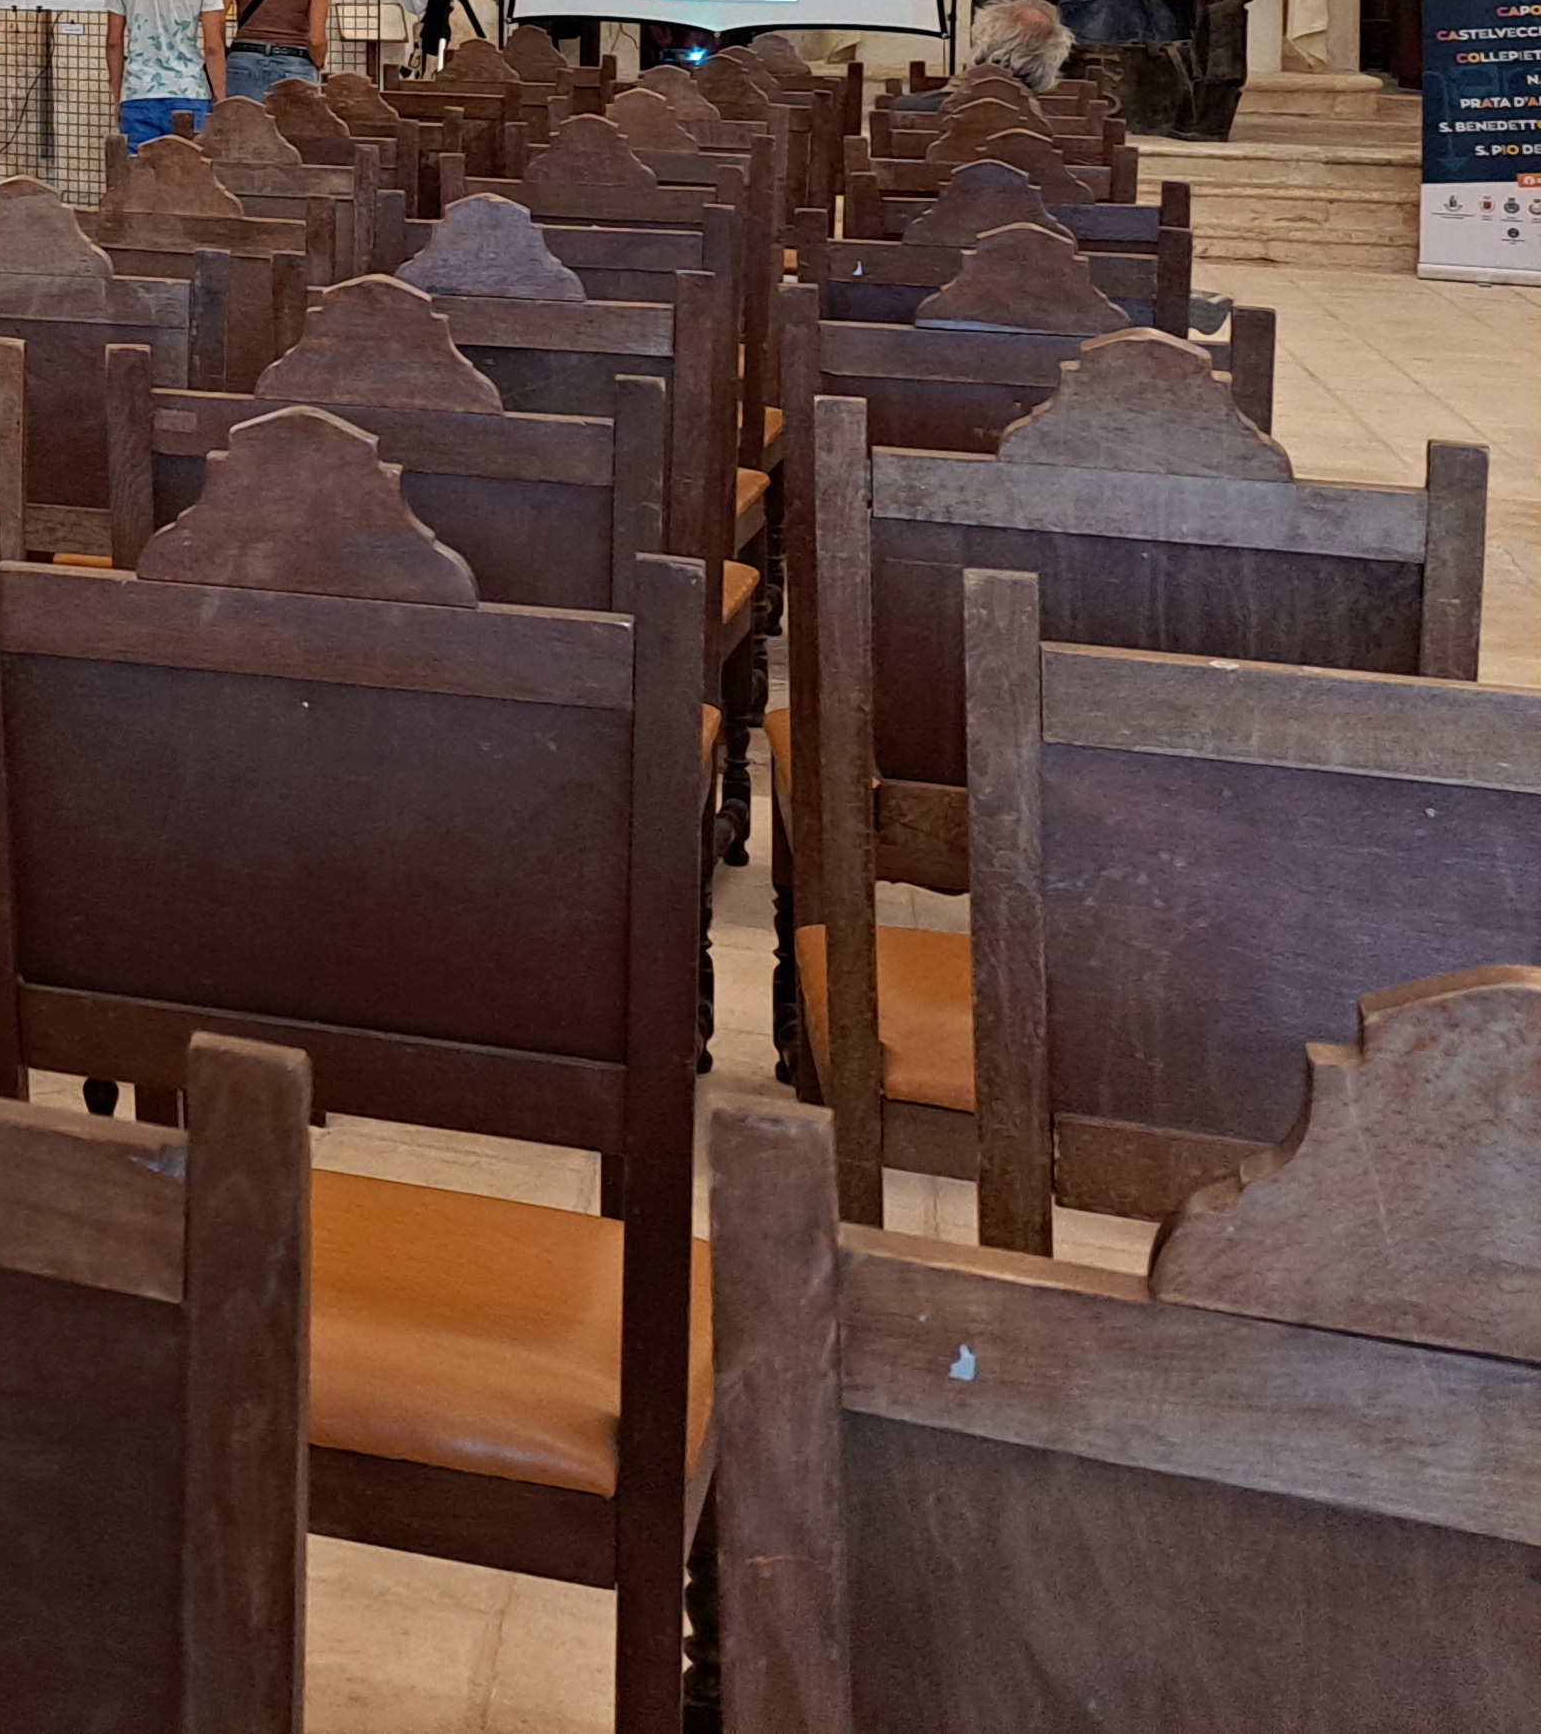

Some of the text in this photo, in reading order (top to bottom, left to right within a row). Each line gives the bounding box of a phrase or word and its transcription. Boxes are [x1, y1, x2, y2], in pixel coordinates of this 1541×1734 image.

[1436, 26, 1541, 41] CASTELVECC
[1460, 95, 1541, 109] PRATA D'A
[1438, 122, 1453, 133] S.
[1474, 145, 1490, 156] S.
[1491, 144, 1520, 156] PIO
